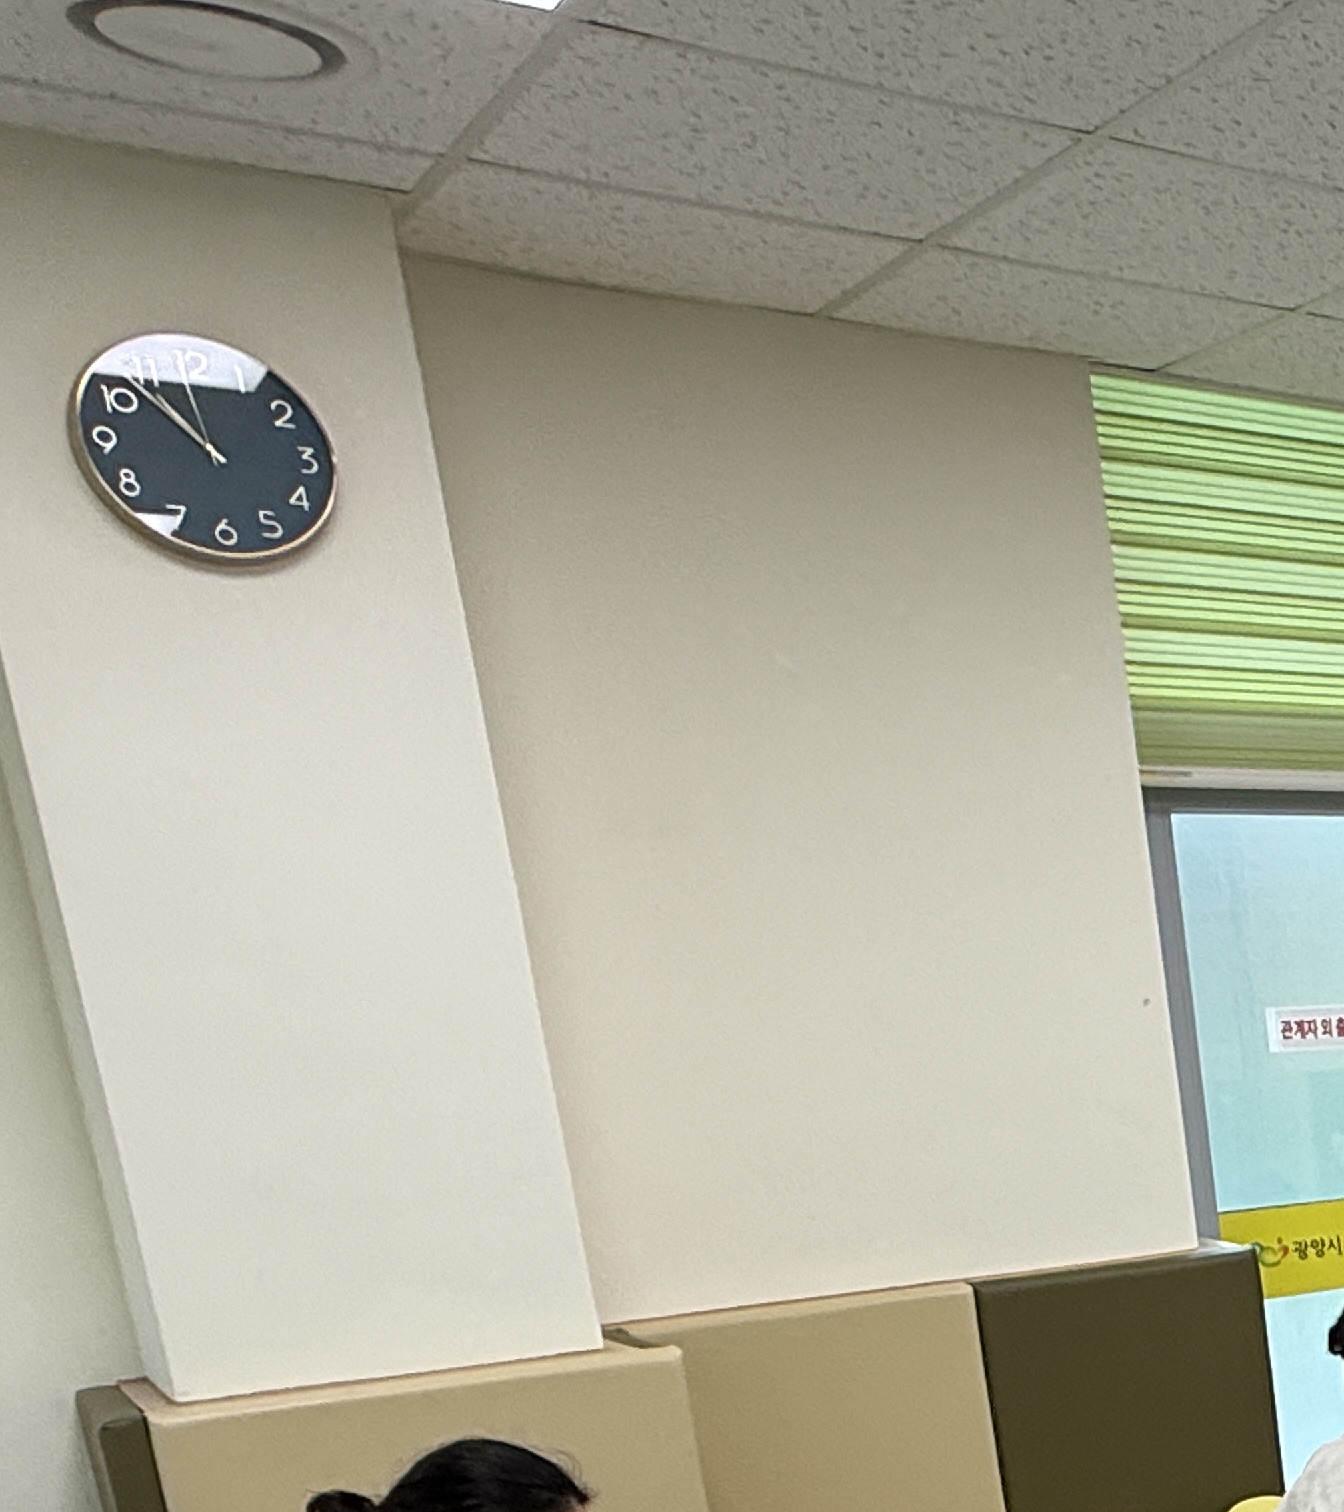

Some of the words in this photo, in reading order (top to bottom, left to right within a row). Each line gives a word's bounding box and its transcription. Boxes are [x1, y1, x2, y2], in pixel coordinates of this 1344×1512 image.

[132, 355, 159, 388] 11
[175, 349, 208, 384] 12
[234, 364, 246, 394] 1
[100, 384, 139, 414] 10
[270, 399, 296, 430] 2
[92, 425, 117, 455] 9
[296, 446, 319, 474] 3
[118, 468, 141, 498] 8
[288, 485, 310, 512] 4
[165, 504, 187, 531] 7
[214, 518, 238, 546] 6
[258, 510, 284, 538] 5
[1280, 1018, 1318, 1040] 관계자
[1321, 1017, 1334, 1038] 외
[1292, 1235, 1343, 1260] 광양시
